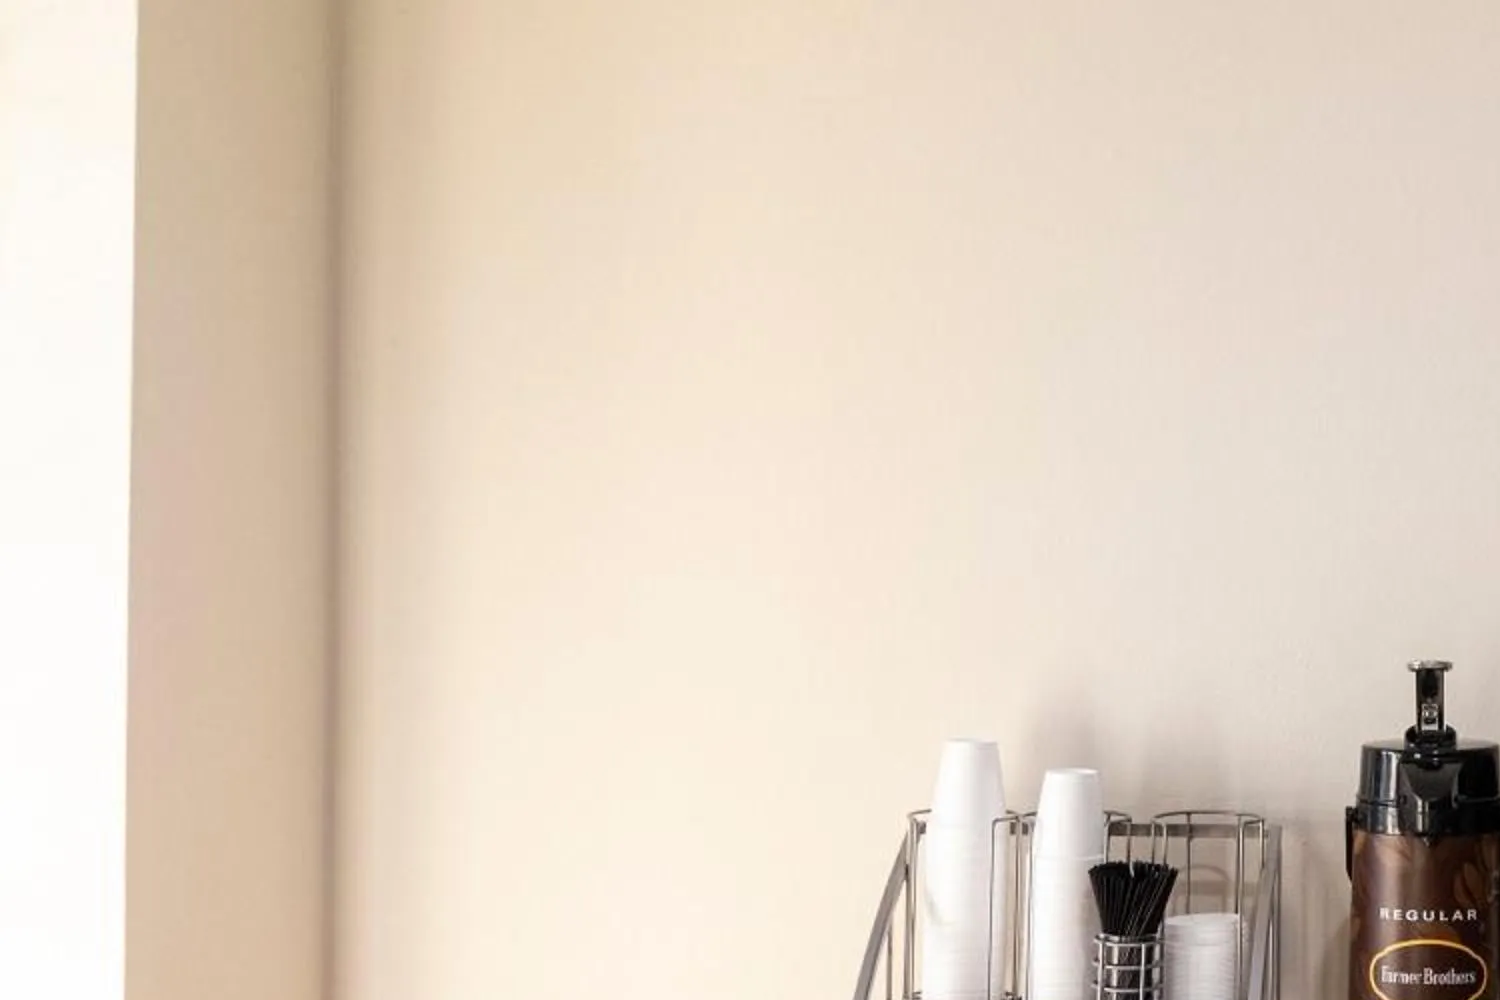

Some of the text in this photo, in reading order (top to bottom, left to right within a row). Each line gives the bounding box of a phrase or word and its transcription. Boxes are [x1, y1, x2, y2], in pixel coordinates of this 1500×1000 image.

[1379, 908, 1478, 922] REGULAR
[1381, 965, 1476, 985] Farmer Brothers
